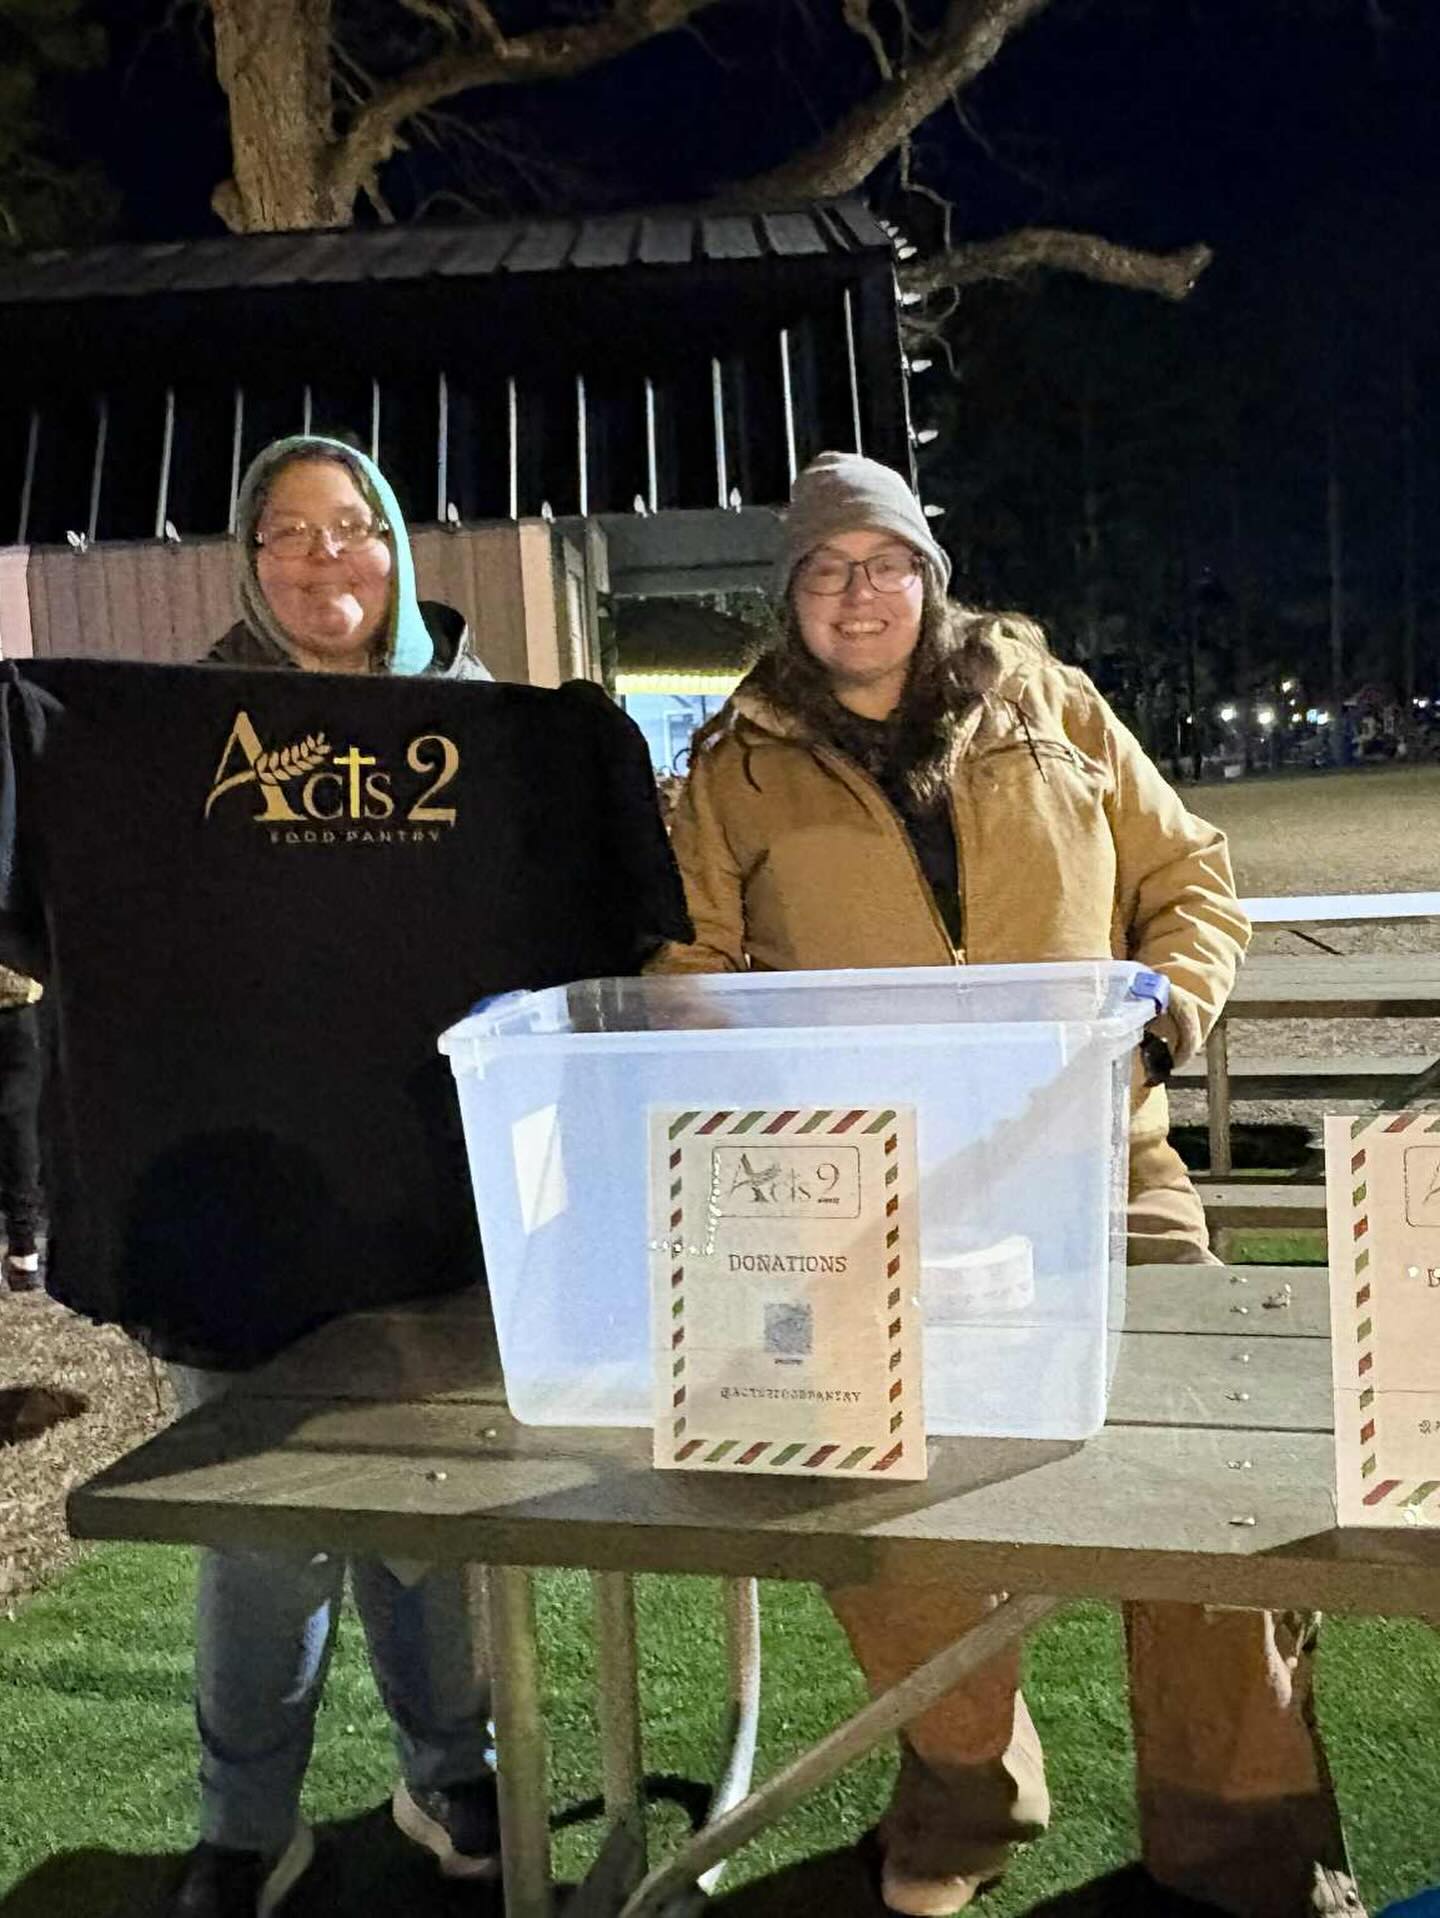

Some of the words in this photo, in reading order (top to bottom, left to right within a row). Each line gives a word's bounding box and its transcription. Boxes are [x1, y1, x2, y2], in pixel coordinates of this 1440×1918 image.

[406, 734, 460, 828] 2
[269, 830, 335, 844] FOOD
[346, 830, 440, 843] PANTRY
[728, 1254, 848, 1273] DONATIONS
